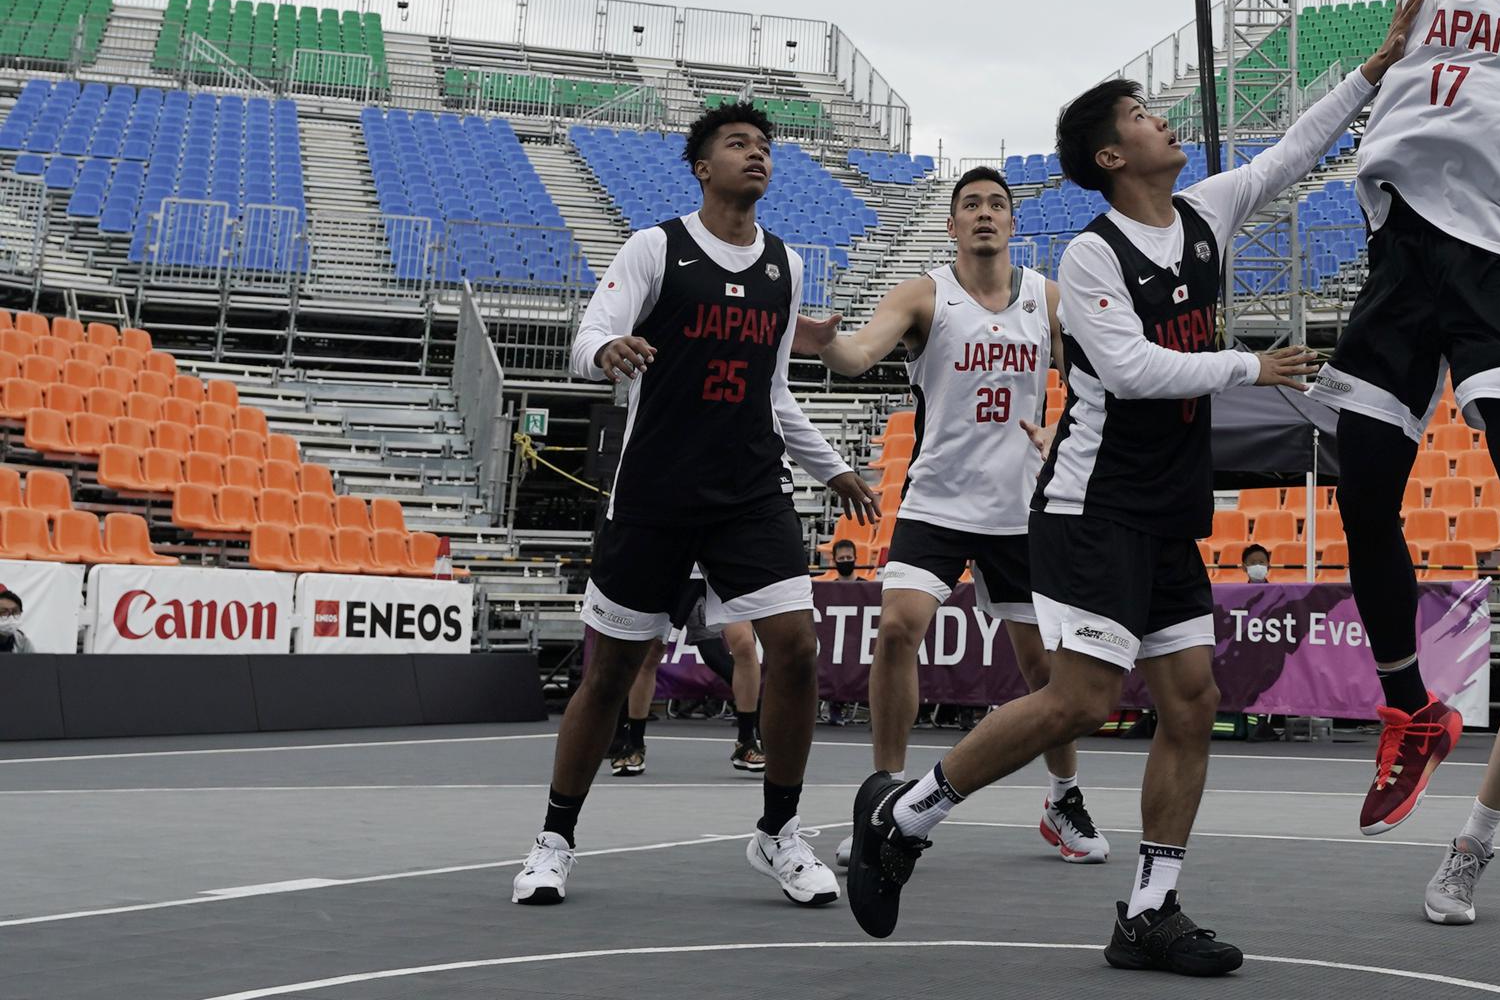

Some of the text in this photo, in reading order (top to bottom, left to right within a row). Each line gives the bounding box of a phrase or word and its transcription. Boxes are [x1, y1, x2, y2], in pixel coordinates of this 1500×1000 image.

[1430, 62, 1471, 107] 17
[683, 303, 777, 346] JAPAN
[954, 342, 1038, 372] JAPAN
[702, 359, 749, 403] 25
[976, 387, 1011, 423] 29
[113, 589, 278, 641] Canon
[315, 600, 462, 642] ENEOS ENEOS
[1230, 609, 1296, 644] Test
